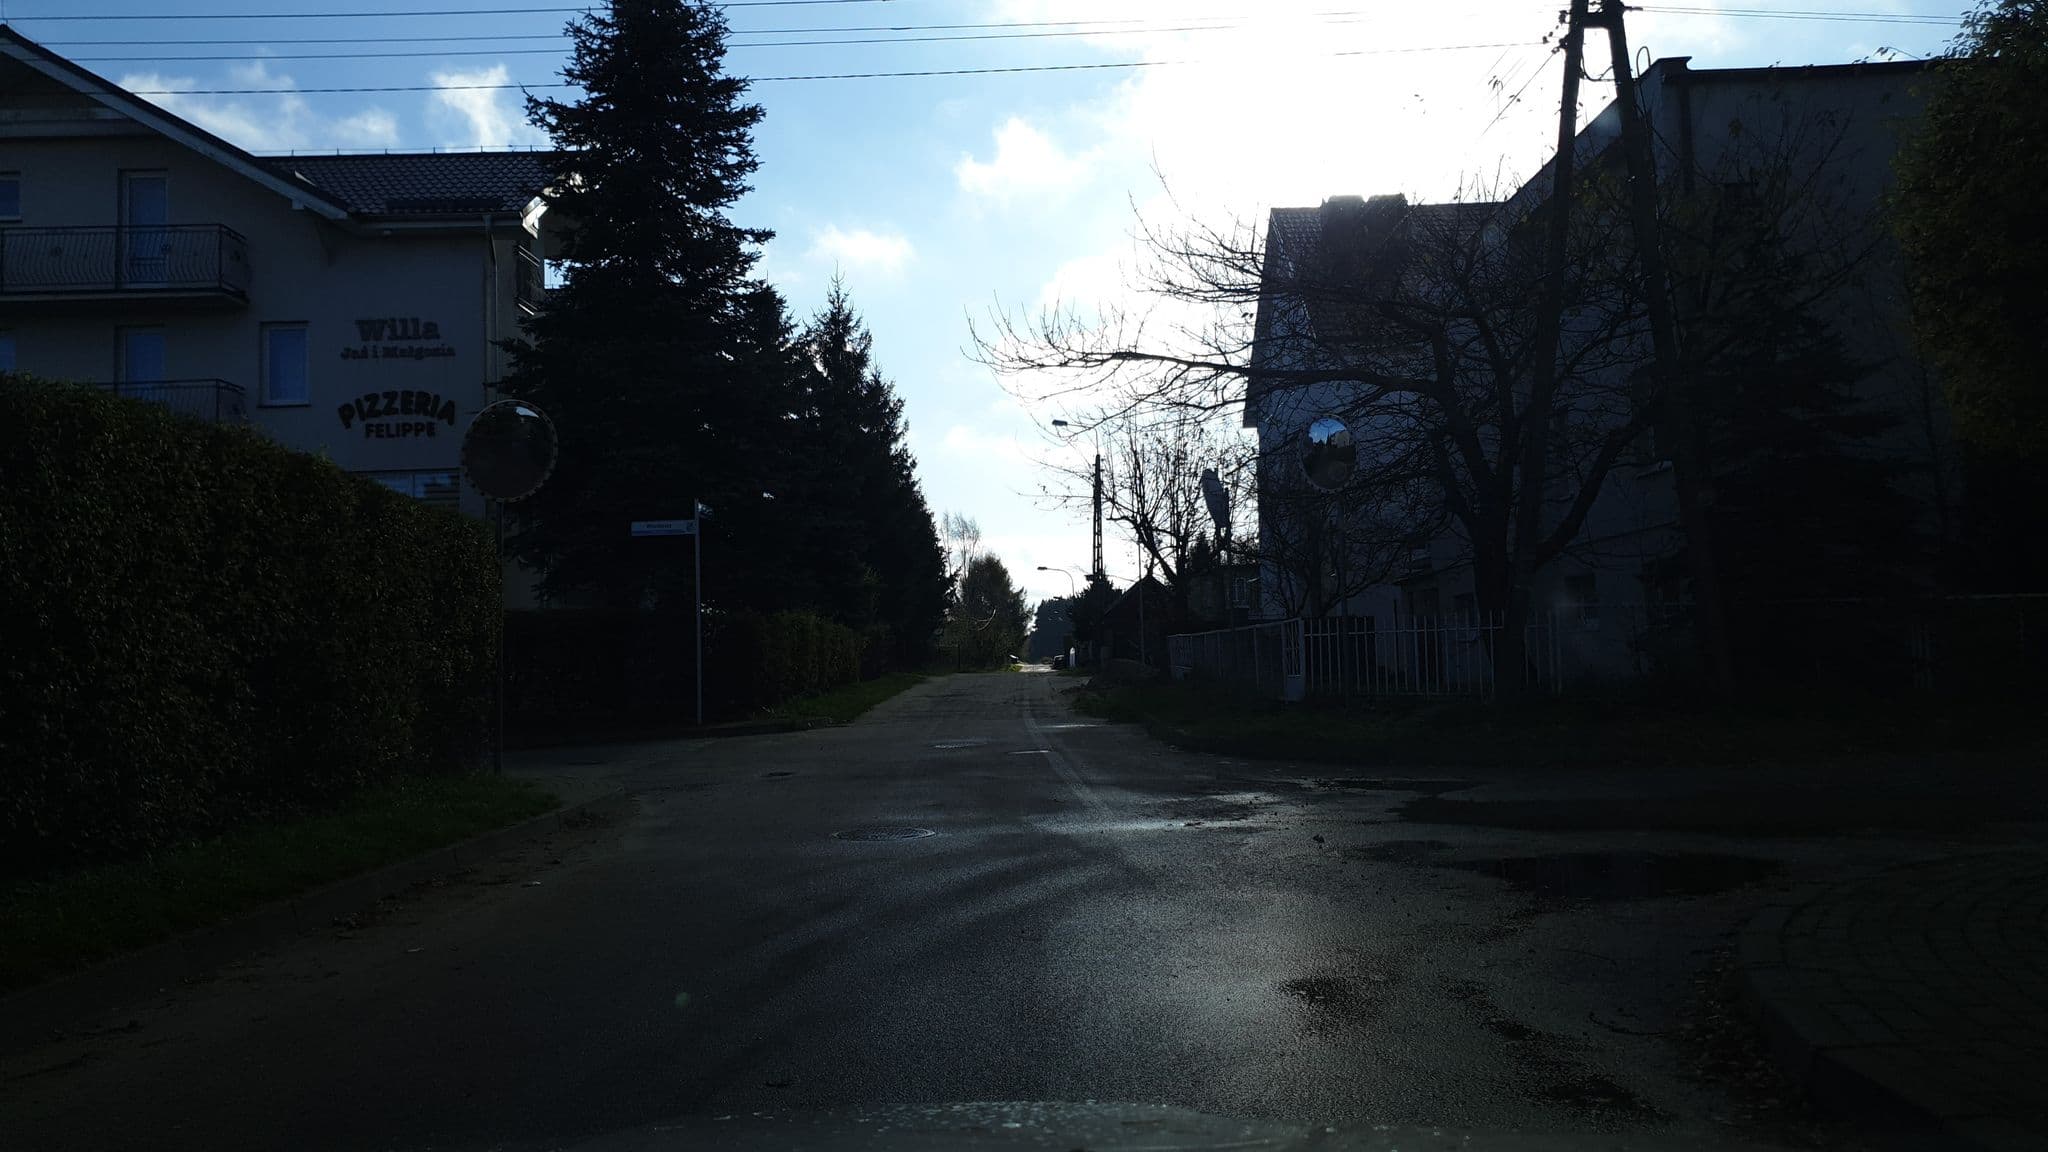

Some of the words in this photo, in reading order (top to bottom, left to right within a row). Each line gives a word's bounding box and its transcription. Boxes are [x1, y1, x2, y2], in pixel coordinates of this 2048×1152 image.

[355, 318, 440, 341] Willa
[338, 391, 455, 429] PIZZERIA
[366, 422, 435, 438] FELIPPE
